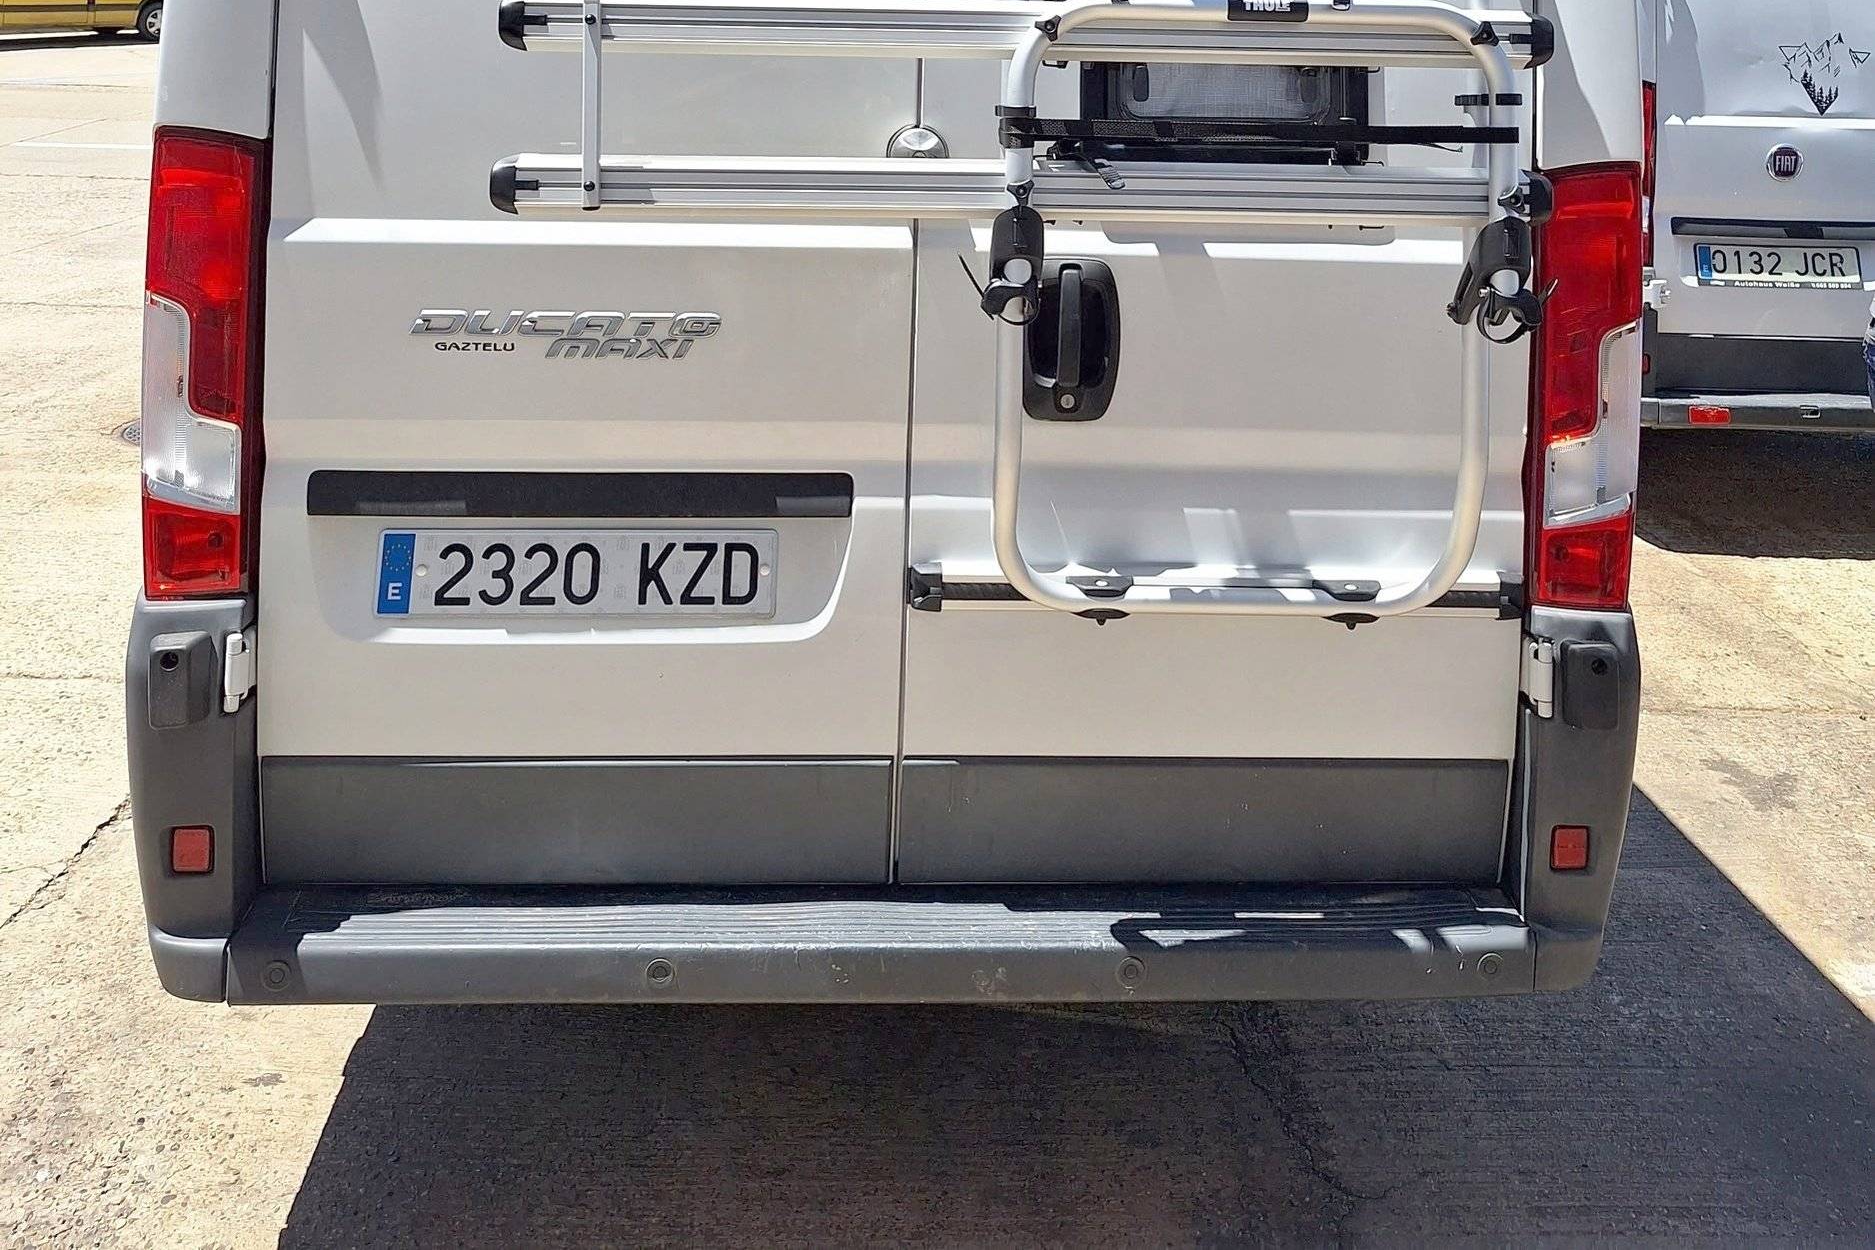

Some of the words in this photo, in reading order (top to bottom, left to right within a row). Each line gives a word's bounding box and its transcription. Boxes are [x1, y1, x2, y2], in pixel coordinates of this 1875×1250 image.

[1775, 155, 1797, 171] FIAT
[1711, 249, 1783, 276] 0132
[1795, 252, 1846, 277] JCR
[1734, 280, 1773, 288] Autohaus
[408, 309, 721, 338] DUCATO
[434, 341, 516, 352] GAZTELU
[544, 337, 694, 360] MAXI
[433, 542, 600, 607] 2320
[637, 542, 760, 606] KZD
[387, 582, 402, 601] E
